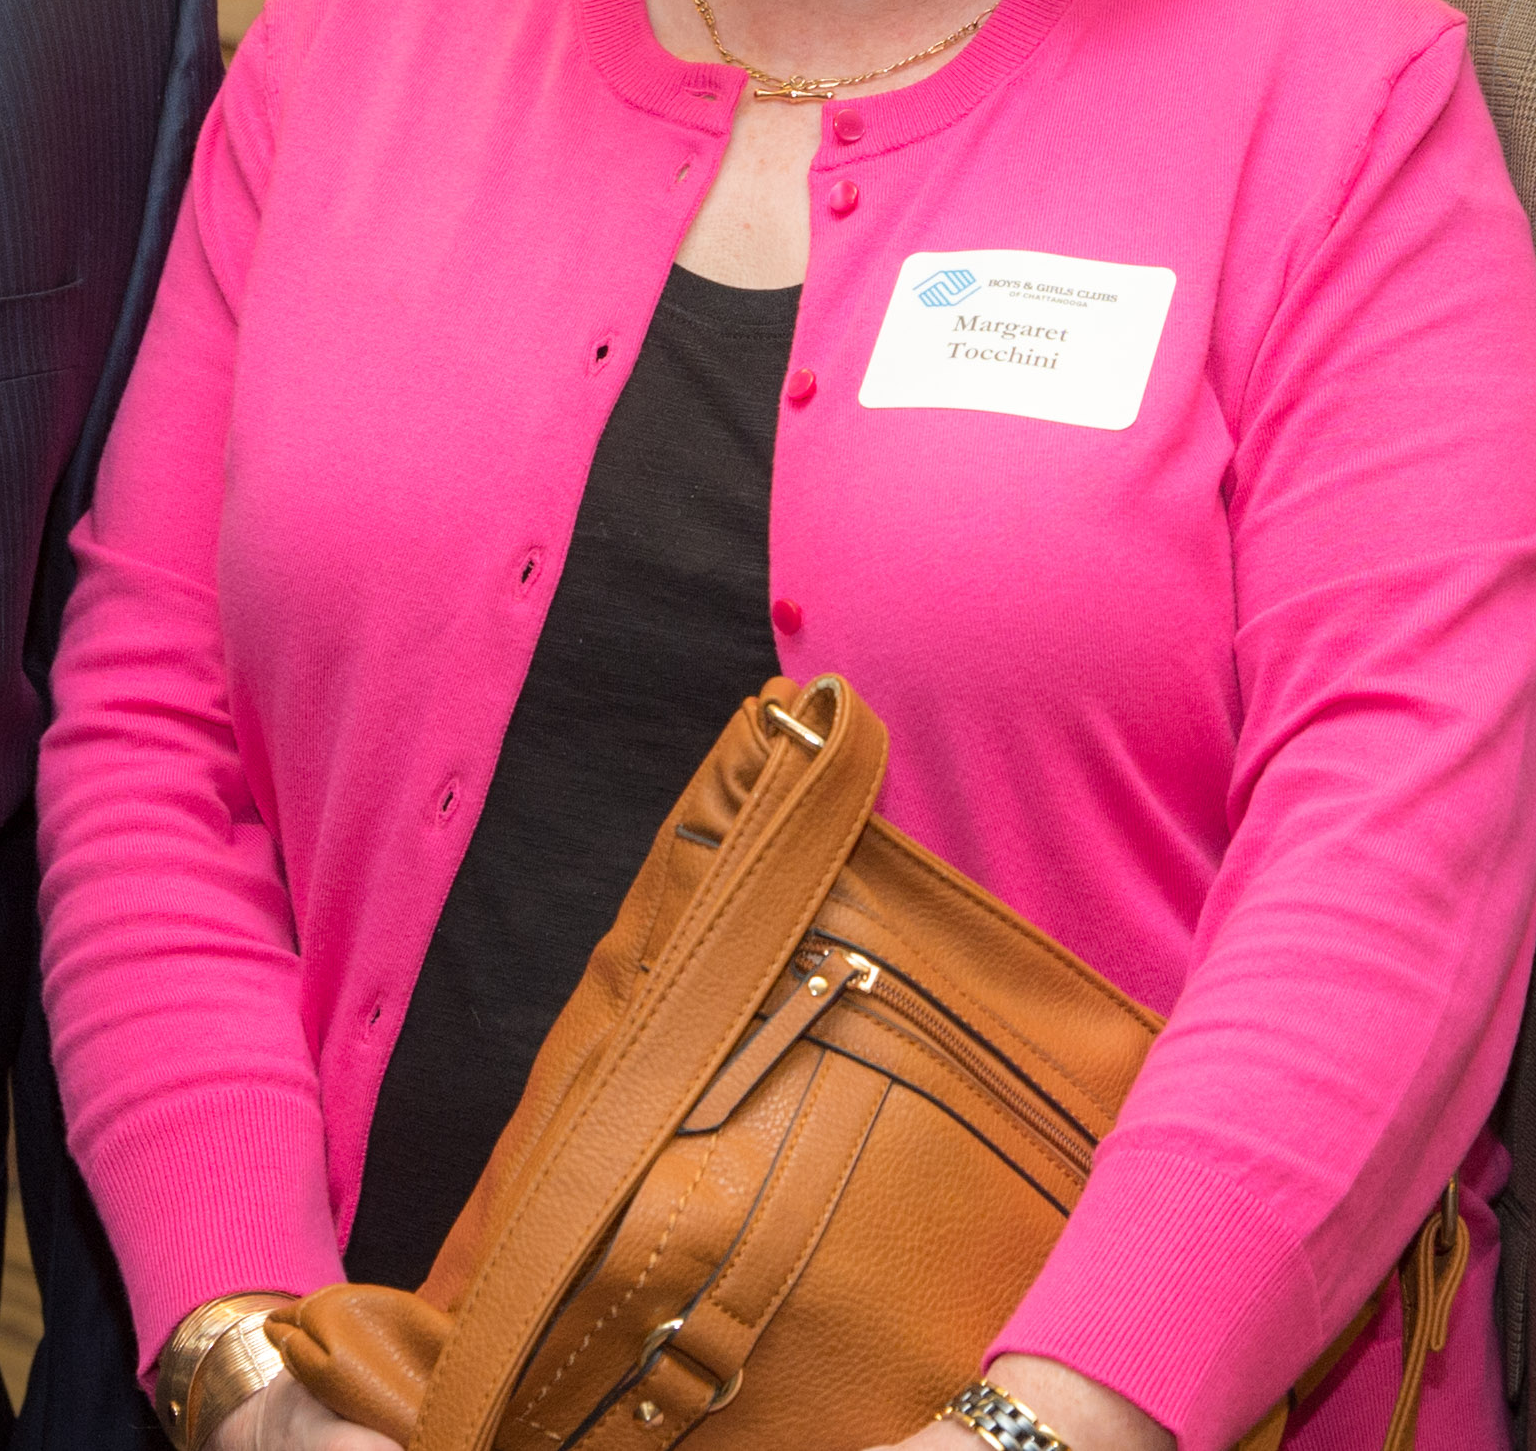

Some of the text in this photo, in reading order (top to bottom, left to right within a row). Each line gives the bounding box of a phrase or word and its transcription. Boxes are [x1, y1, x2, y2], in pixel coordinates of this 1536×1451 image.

[988, 279, 1119, 303] BOYS & GIRLS CLUBS
[1023, 292, 1088, 308] CHATTANOOGA
[952, 314, 1069, 342] Margaret
[947, 342, 1060, 370] Tocchini
